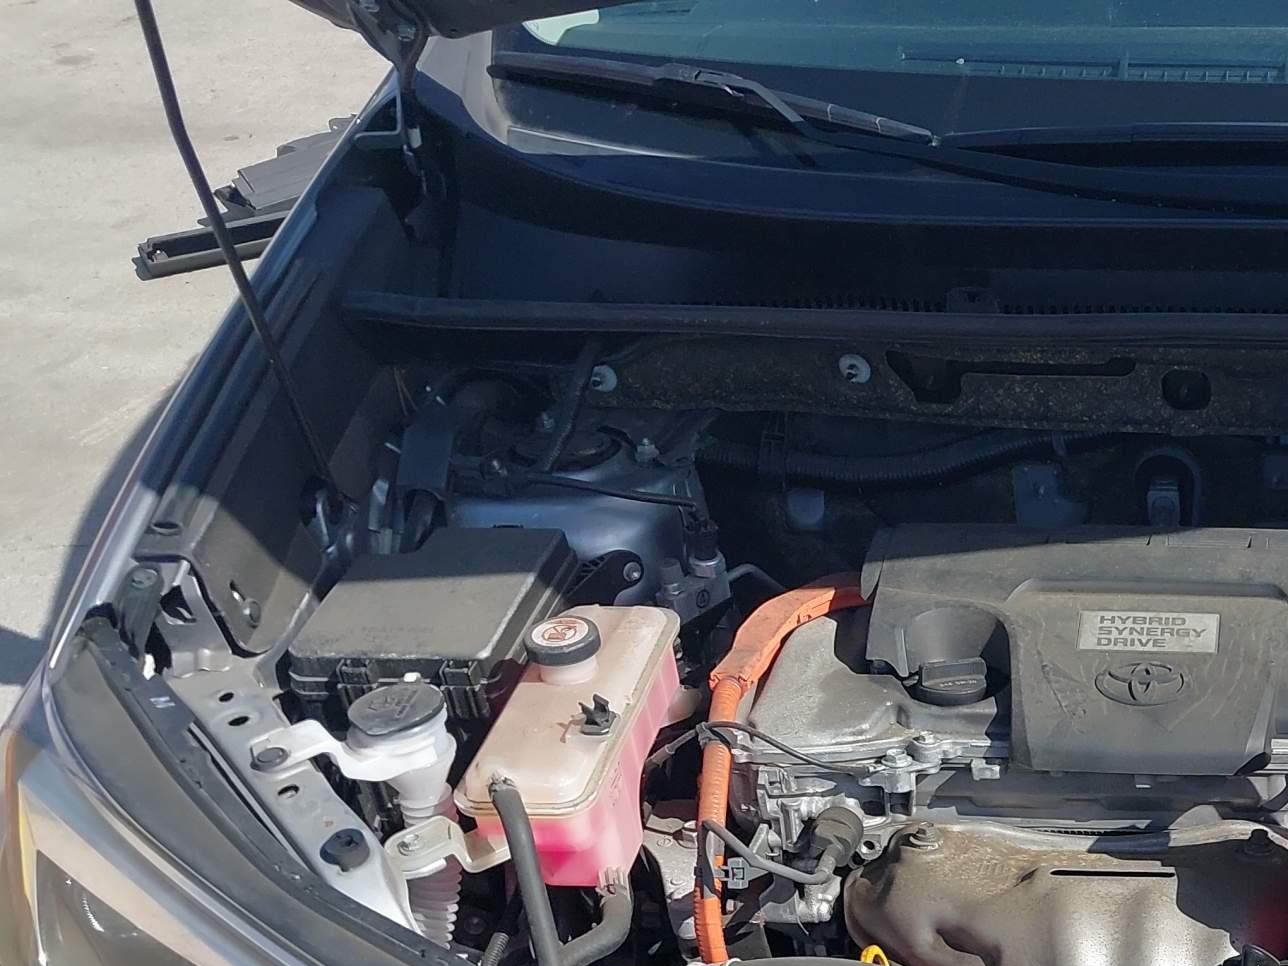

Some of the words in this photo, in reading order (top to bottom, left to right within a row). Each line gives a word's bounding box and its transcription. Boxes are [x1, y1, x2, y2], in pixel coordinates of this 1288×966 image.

[1099, 615, 1186, 626] HYBRID
[1098, 626, 1207, 638] SYNERGY
[1096, 637, 1166, 648] DRIVE
